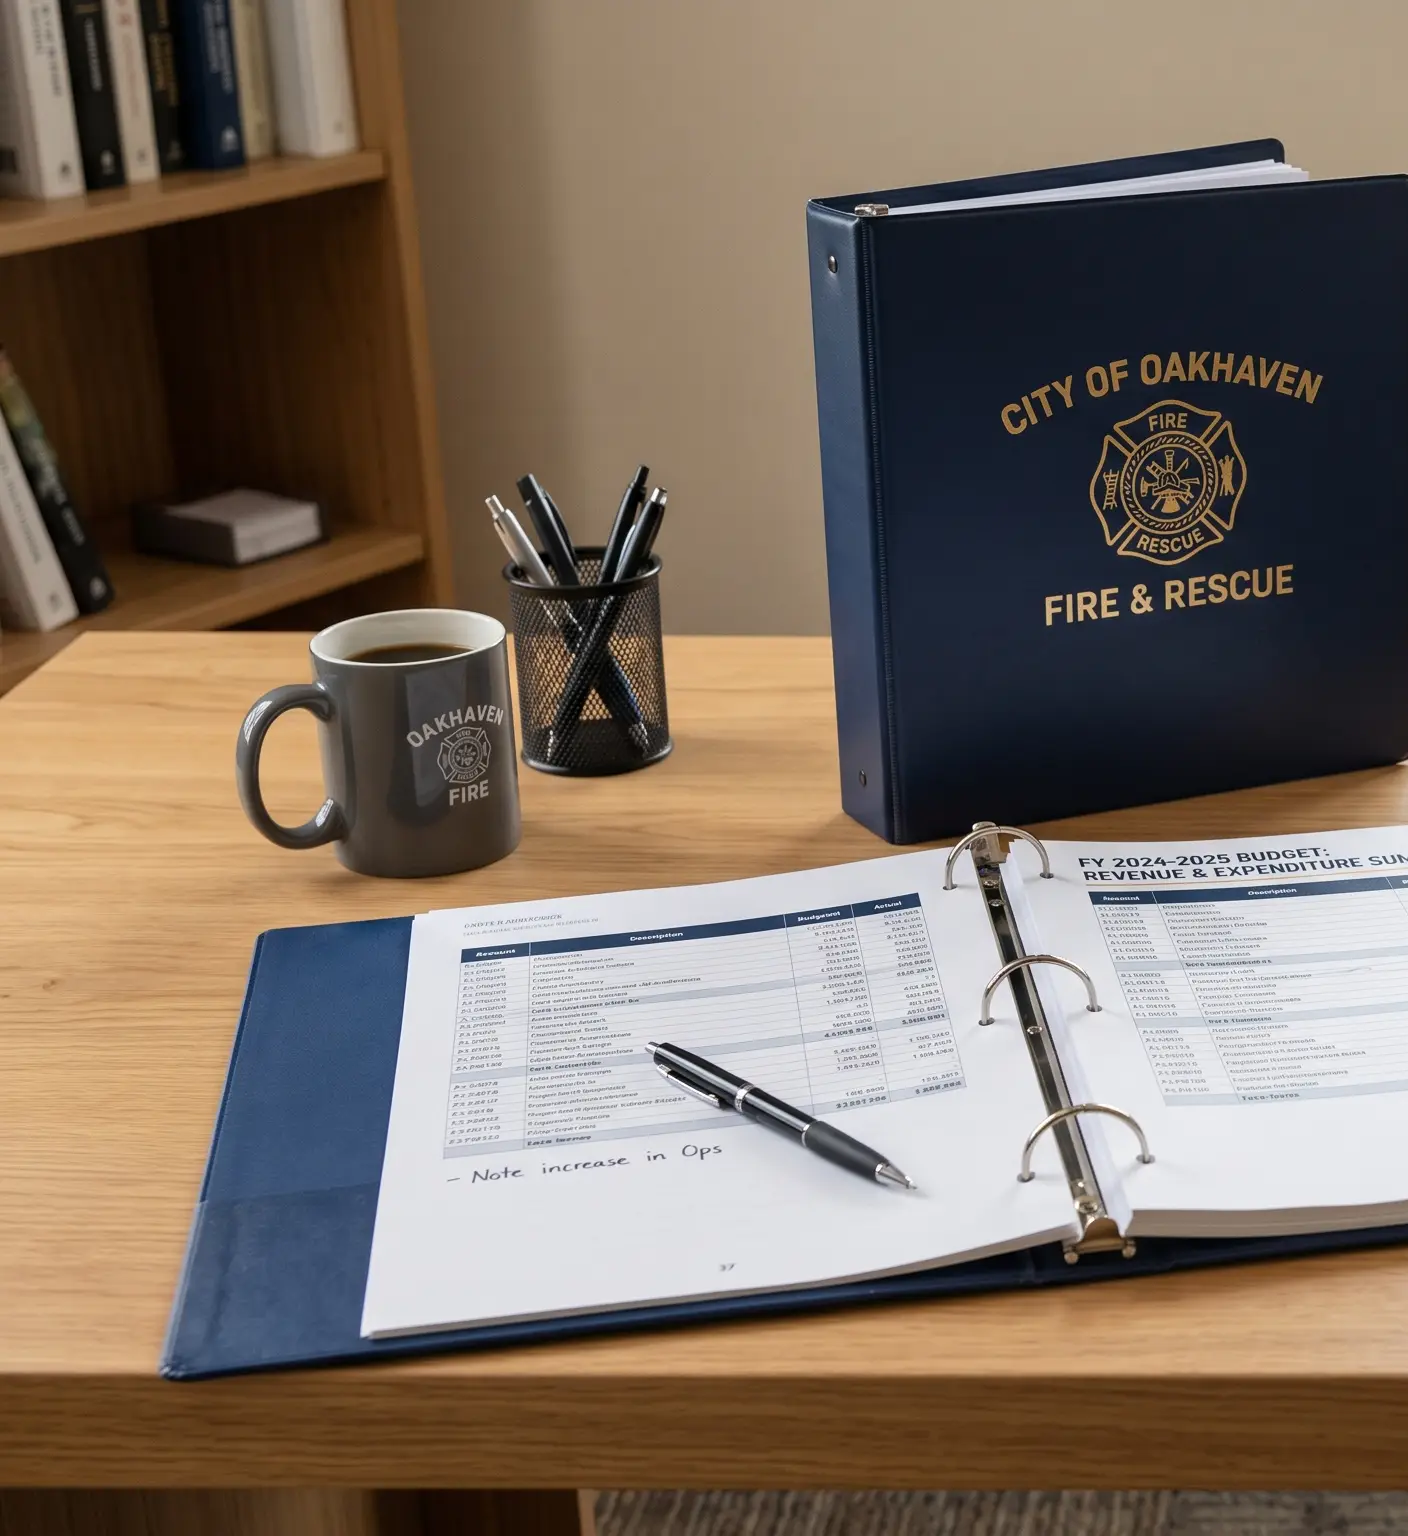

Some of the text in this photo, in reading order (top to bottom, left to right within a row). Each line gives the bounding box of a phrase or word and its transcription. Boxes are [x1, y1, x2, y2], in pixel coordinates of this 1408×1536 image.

[1001, 351, 1323, 436] CITY OF OAKHAVEN
[1148, 412, 1188, 432] FIRE
[1137, 528, 1204, 554] RESCUE
[1045, 564, 1294, 626] FIRE & RESCUE
[406, 704, 504, 748] OAKHAVEN
[449, 780, 489, 806] FIRE
[1078, 856, 1104, 868] FY
[1236, 846, 1330, 863] BUDGET:
[1083, 864, 1189, 882] REVENUE
[1192, 864, 1209, 879] &
[1212, 855, 1366, 878] EXPENDITURE
[471, 1167, 525, 1185] Note
[541, 1154, 630, 1175] increase
[646, 1149, 666, 1163] in
[681, 1143, 723, 1162] Ops
